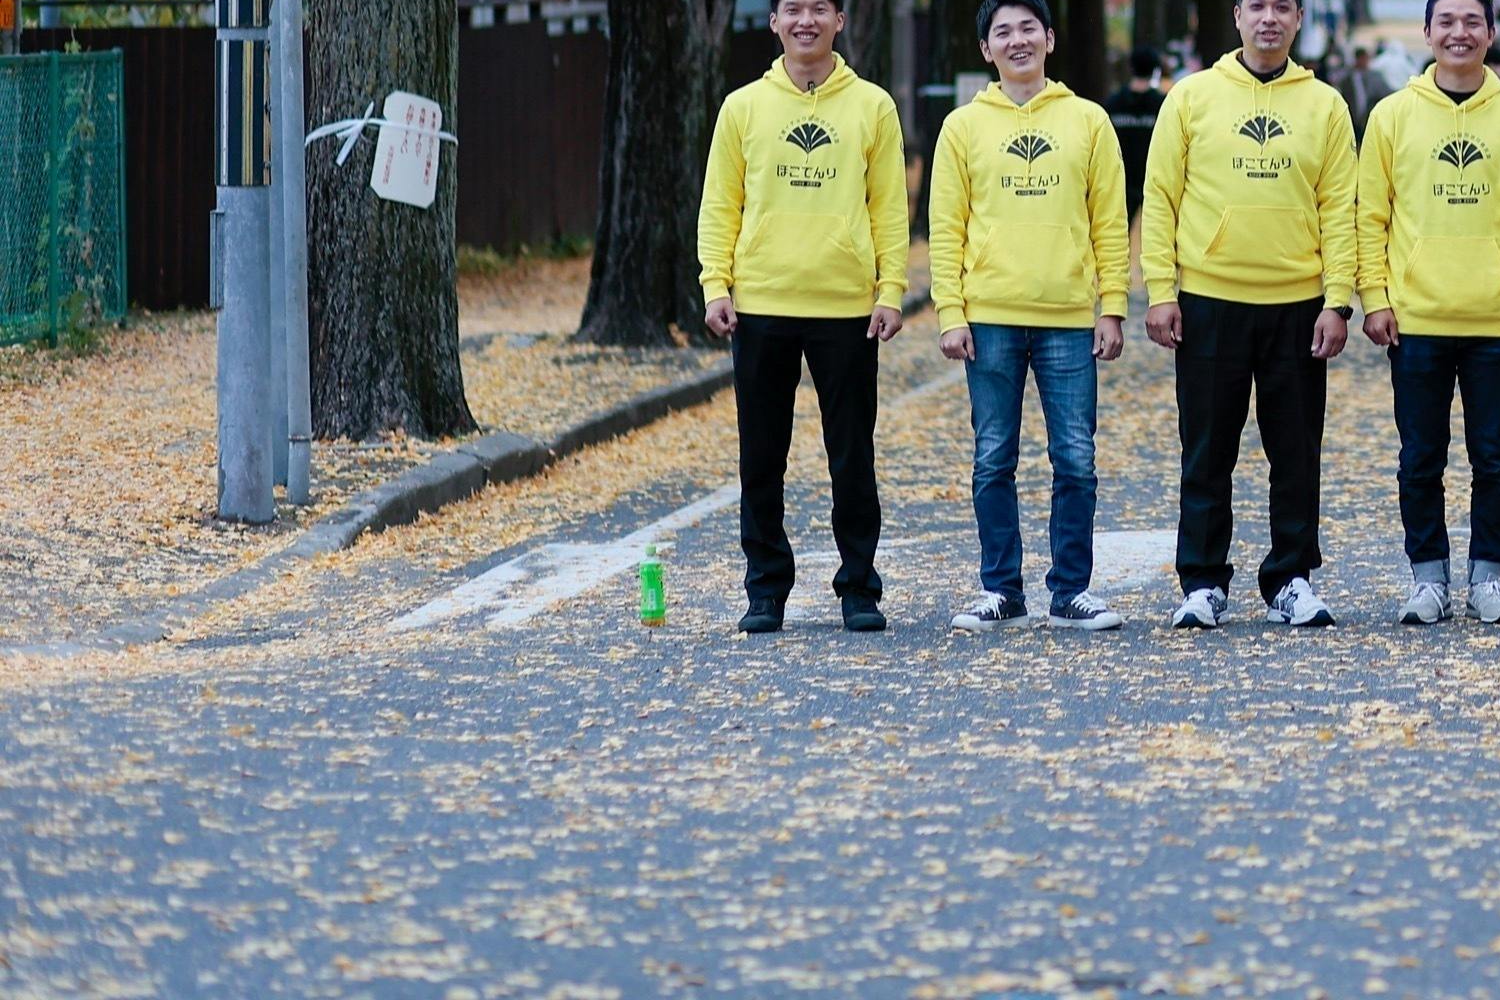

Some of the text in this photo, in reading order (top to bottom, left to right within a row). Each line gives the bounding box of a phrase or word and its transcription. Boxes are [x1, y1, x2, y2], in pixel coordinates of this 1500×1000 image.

[1233, 156, 1292, 170] ほこてんり
[777, 162, 836, 179] ほこてんり
[1001, 173, 1059, 188] ほこてんり
[1433, 183, 1490, 196] ほこてんり
